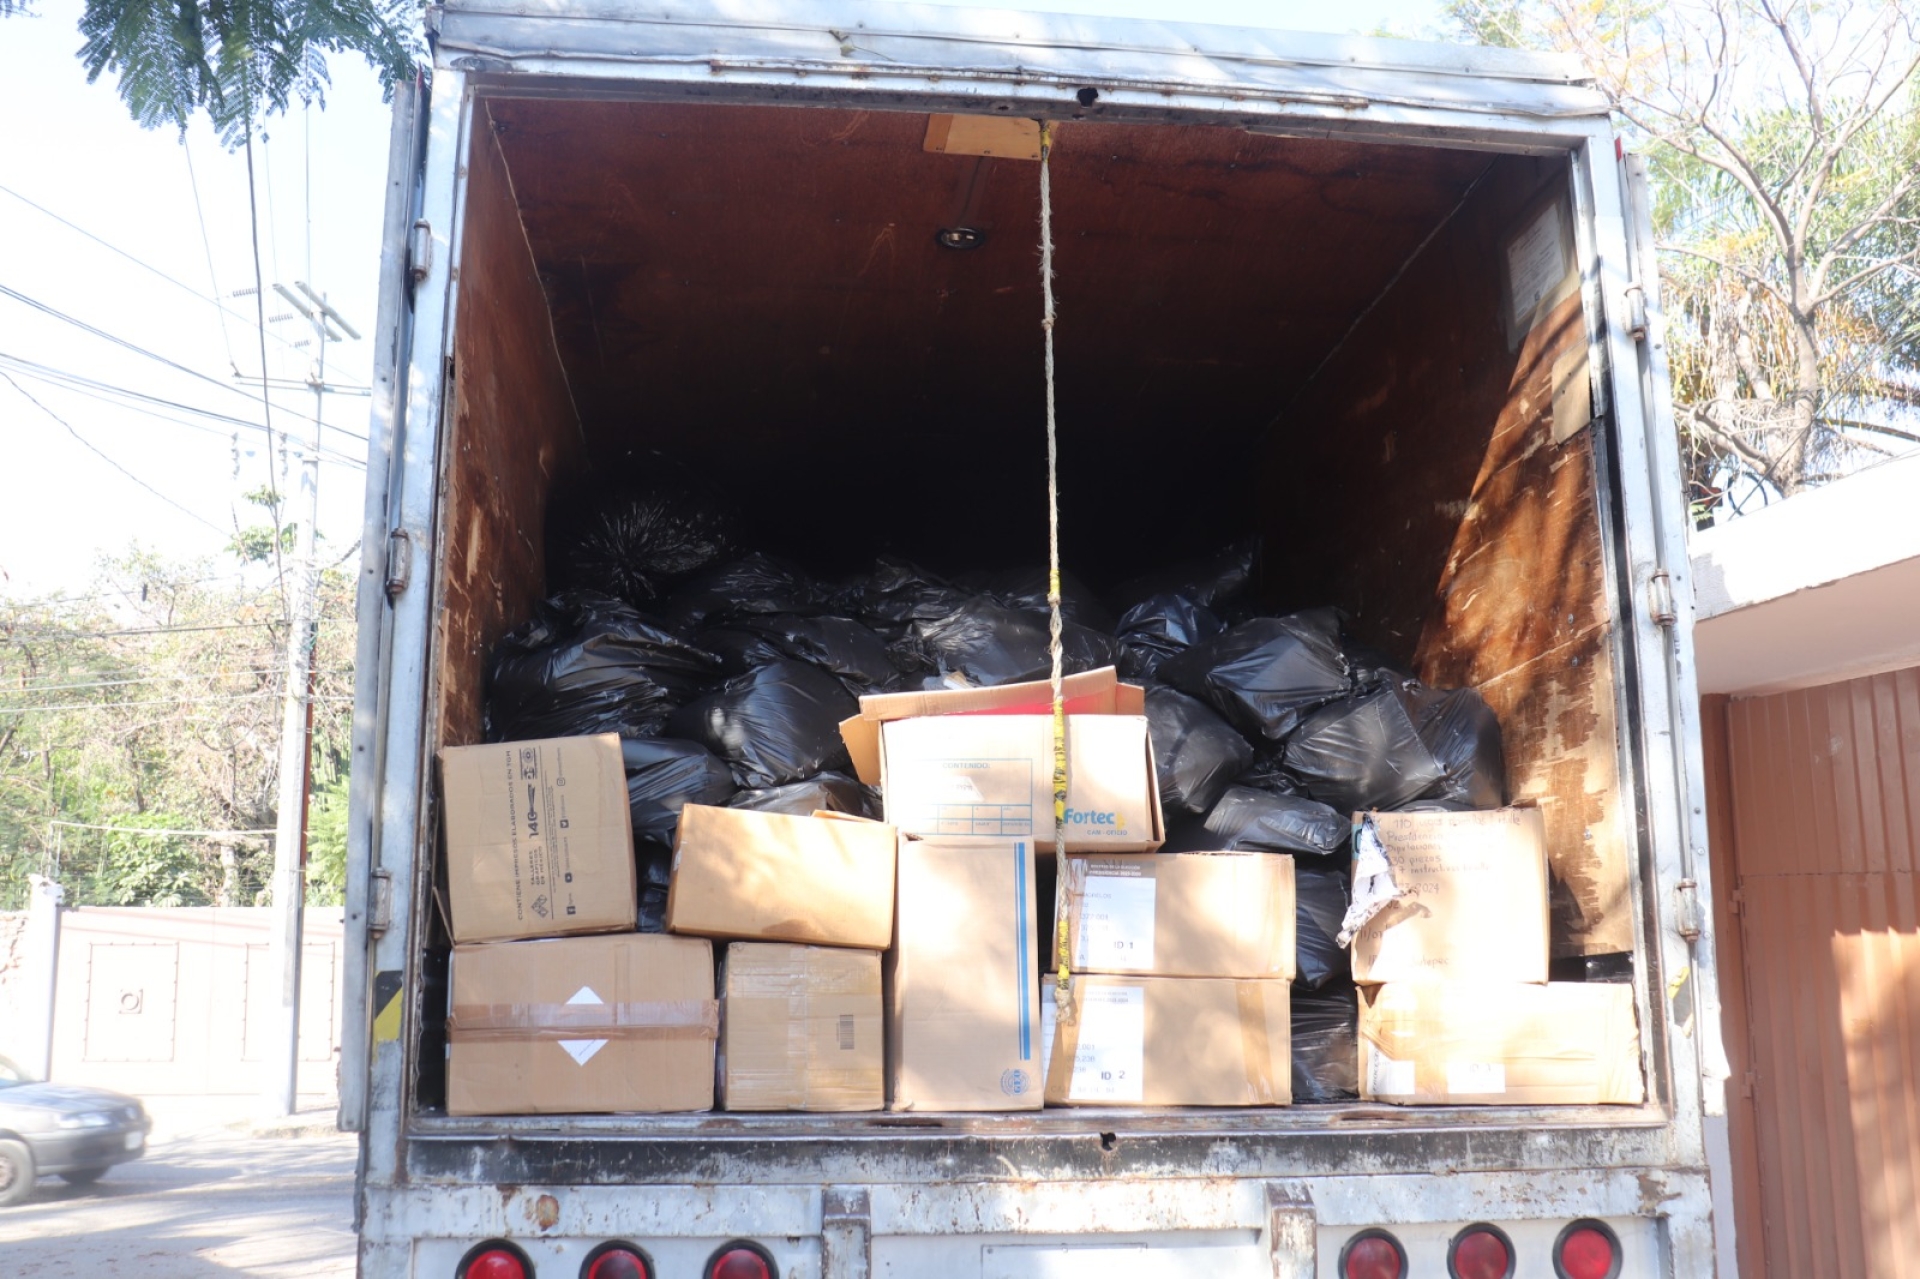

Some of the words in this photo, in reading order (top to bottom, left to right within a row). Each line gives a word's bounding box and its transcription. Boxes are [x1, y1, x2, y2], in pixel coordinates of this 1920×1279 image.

[509, 781, 518, 836] ELABORADOS
[1063, 808, 1115, 825] Fortec
[512, 837, 520, 878] IMPRESOS
[515, 879, 524, 921] CONTIENE
[1113, 940, 1124, 950] ID
[1100, 1070, 1112, 1081] ID
[1117, 1069, 1126, 1080] 2
